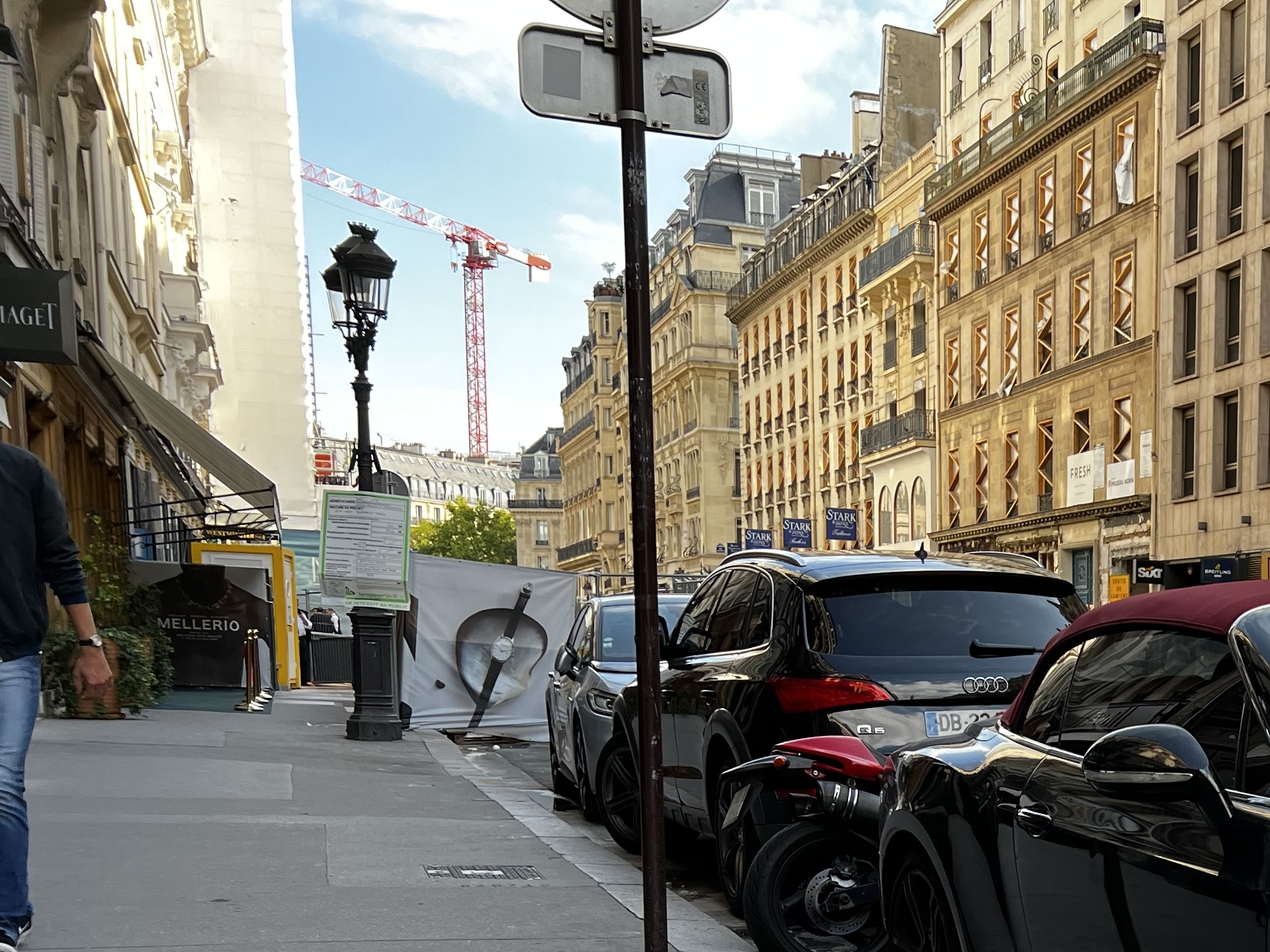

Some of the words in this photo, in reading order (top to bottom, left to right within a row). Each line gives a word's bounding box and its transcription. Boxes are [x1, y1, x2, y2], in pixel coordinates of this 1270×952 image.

[0, 302, 57, 330] IAGET
[1070, 464, 1091, 479] FRESH
[826, 509, 856, 523] STARK
[783, 519, 811, 532] STARK
[745, 530, 772, 542] STARK
[157, 617, 240, 632] MELLERIO
